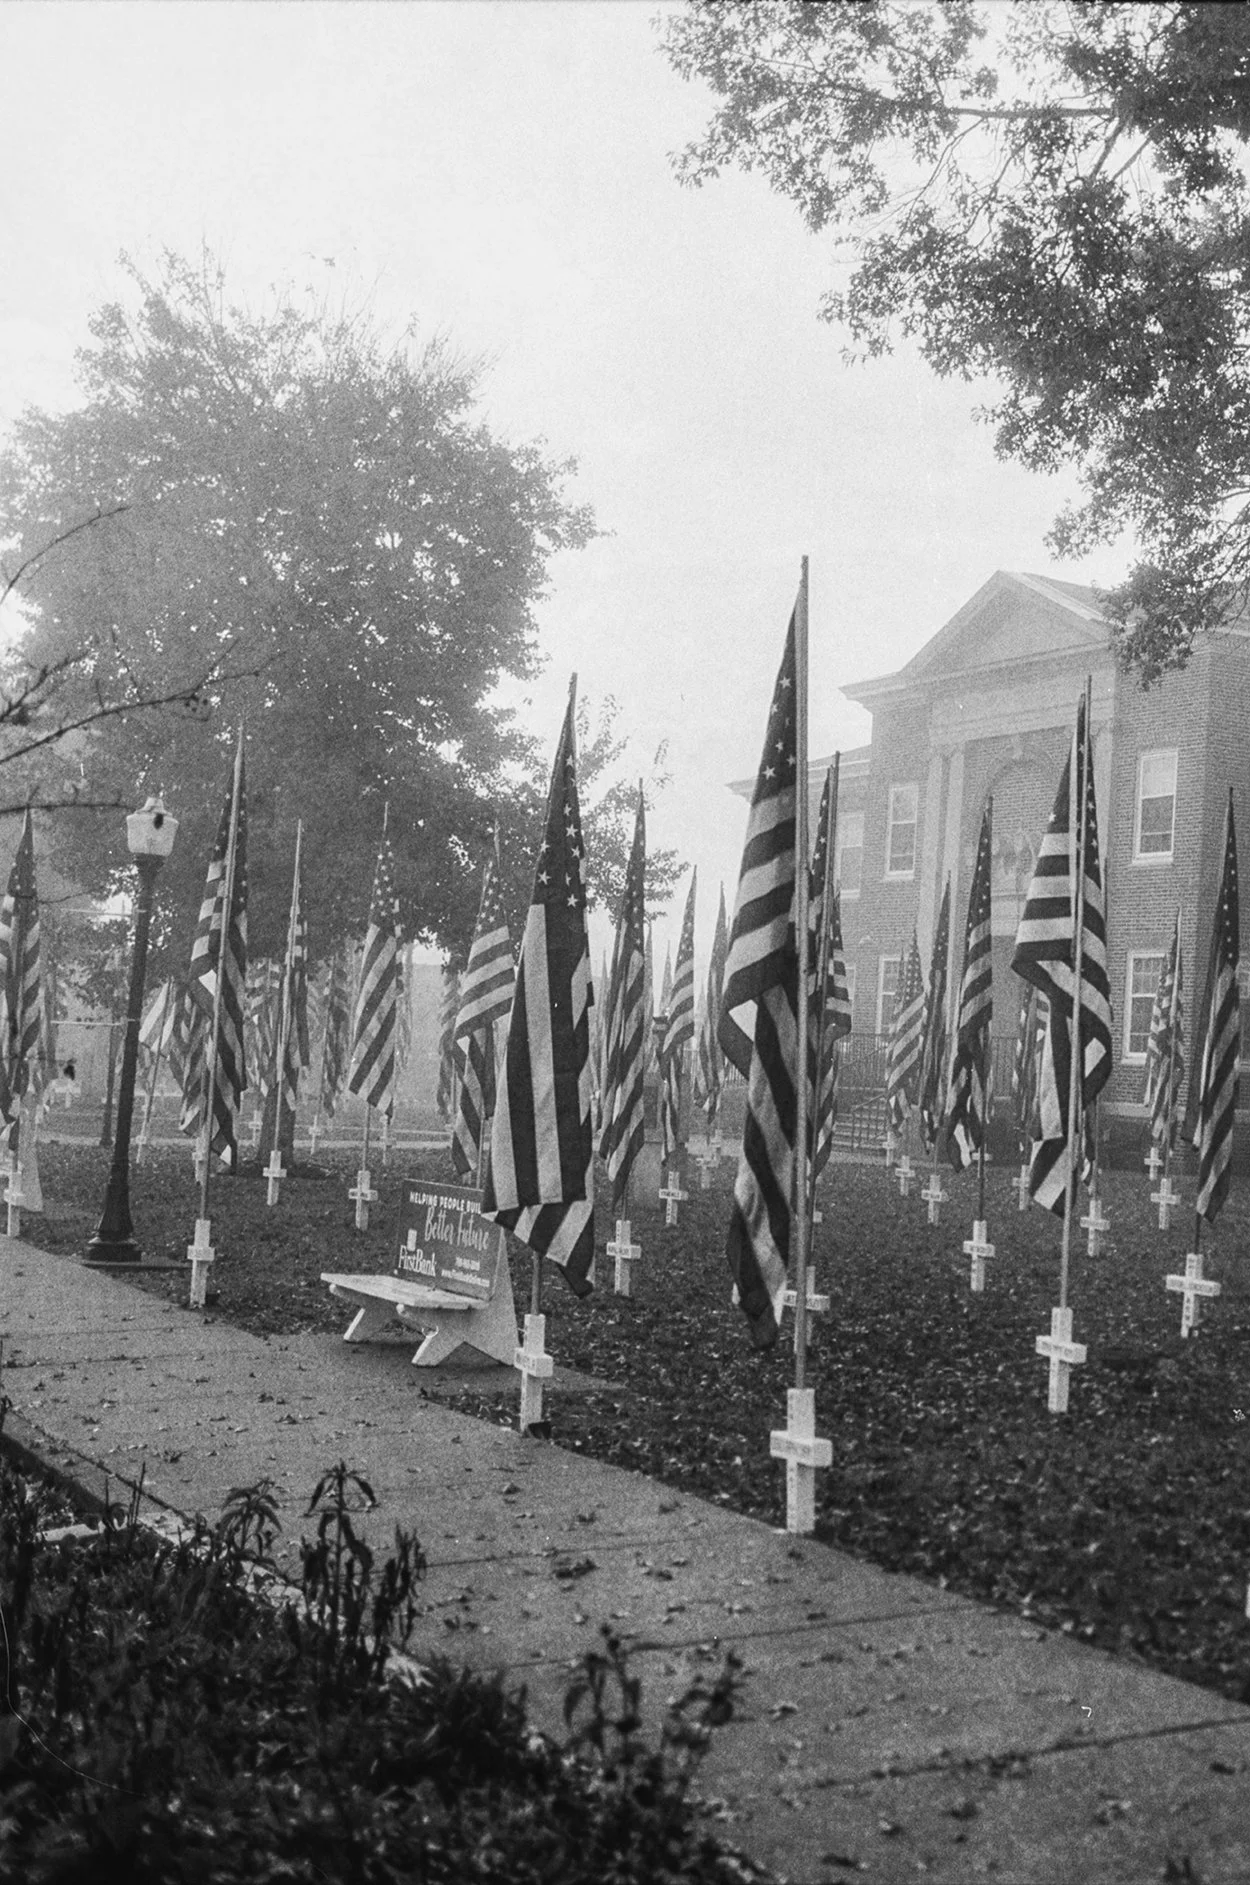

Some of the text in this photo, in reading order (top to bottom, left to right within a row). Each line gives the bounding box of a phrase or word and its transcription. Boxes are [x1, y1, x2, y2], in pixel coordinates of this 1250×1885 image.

[409, 1191, 437, 1207] HELPING
[439, 1195, 465, 1212] PEOPLE
[424, 1206, 489, 1251] Better Future
[398, 1244, 436, 1277] FirstBank
